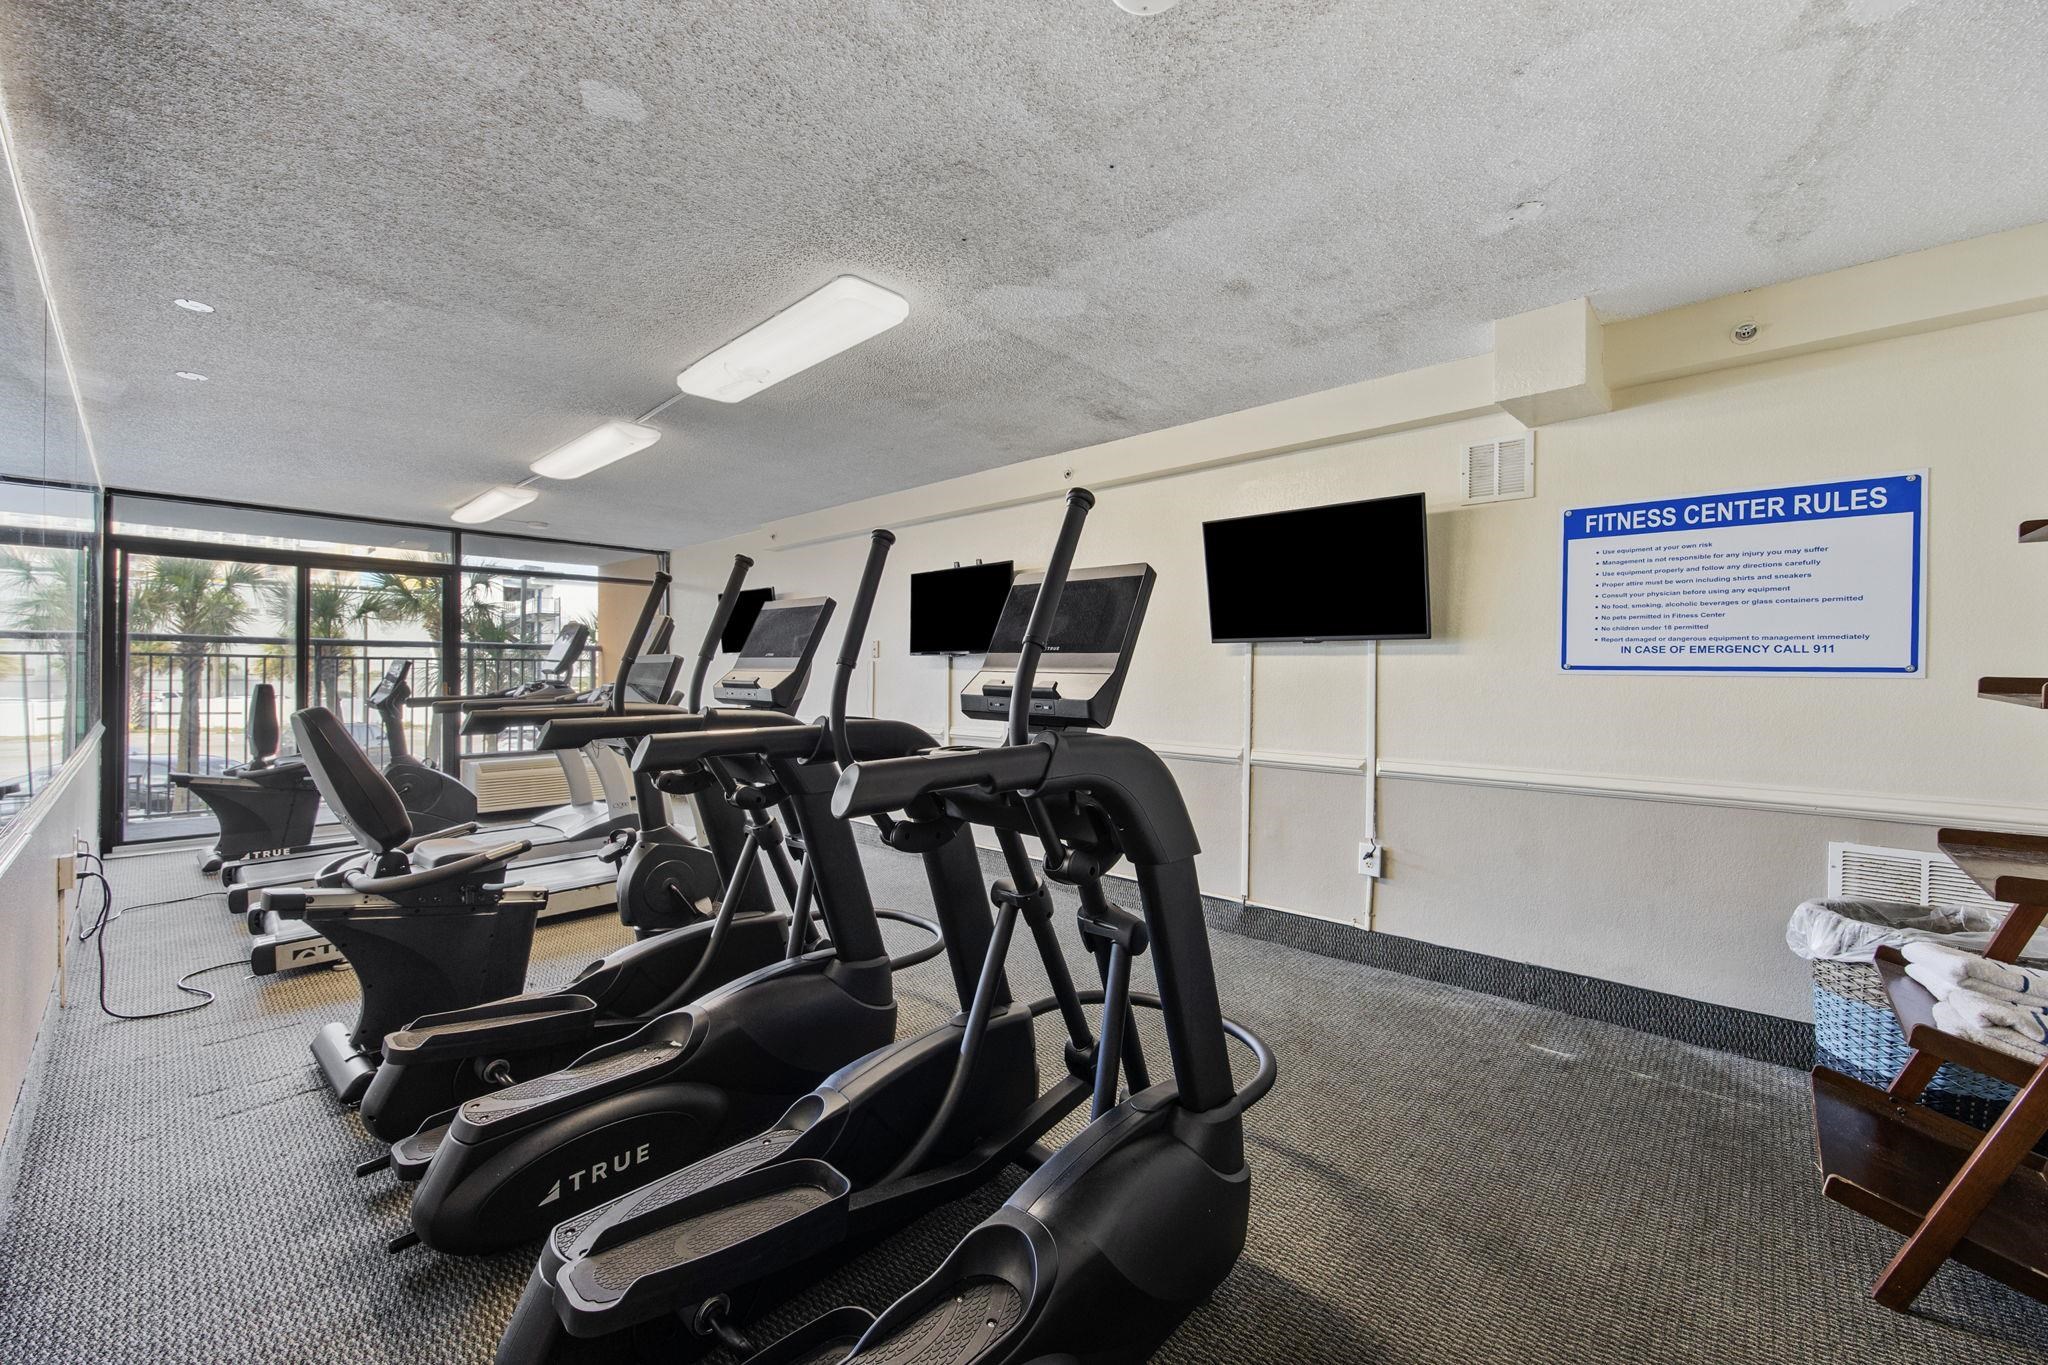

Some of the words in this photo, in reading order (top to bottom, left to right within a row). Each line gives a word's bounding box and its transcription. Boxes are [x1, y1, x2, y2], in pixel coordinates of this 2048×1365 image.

[1585, 507, 1677, 533] FITNESS
[1684, 496, 1785, 525] CENTER
[1793, 486, 1888, 515] RULES
[1616, 546, 1654, 554] equipment
[1602, 558, 1646, 566] Management
[1668, 554, 1712, 562] responsible
[1766, 550, 1782, 558] you
[1804, 546, 1828, 554] suffer
[1616, 568, 1654, 576] equipment
[1746, 586, 1790, 594] equipment
[1752, 598, 1774, 606] glass
[1822, 594, 1864, 604] permitted
[1624, 636, 1656, 644] damaged
[1620, 646, 1632, 654] IN
[1634, 646, 1666, 654] CASE
[1670, 646, 1686, 654] OF
[1690, 644, 1770, 654] EMERGENCY
[1774, 644, 1810, 654] CALL
[1812, 644, 1834, 654] 911
[252, 848, 290, 859] TRUE
[568, 1143, 650, 1192] TRUE
